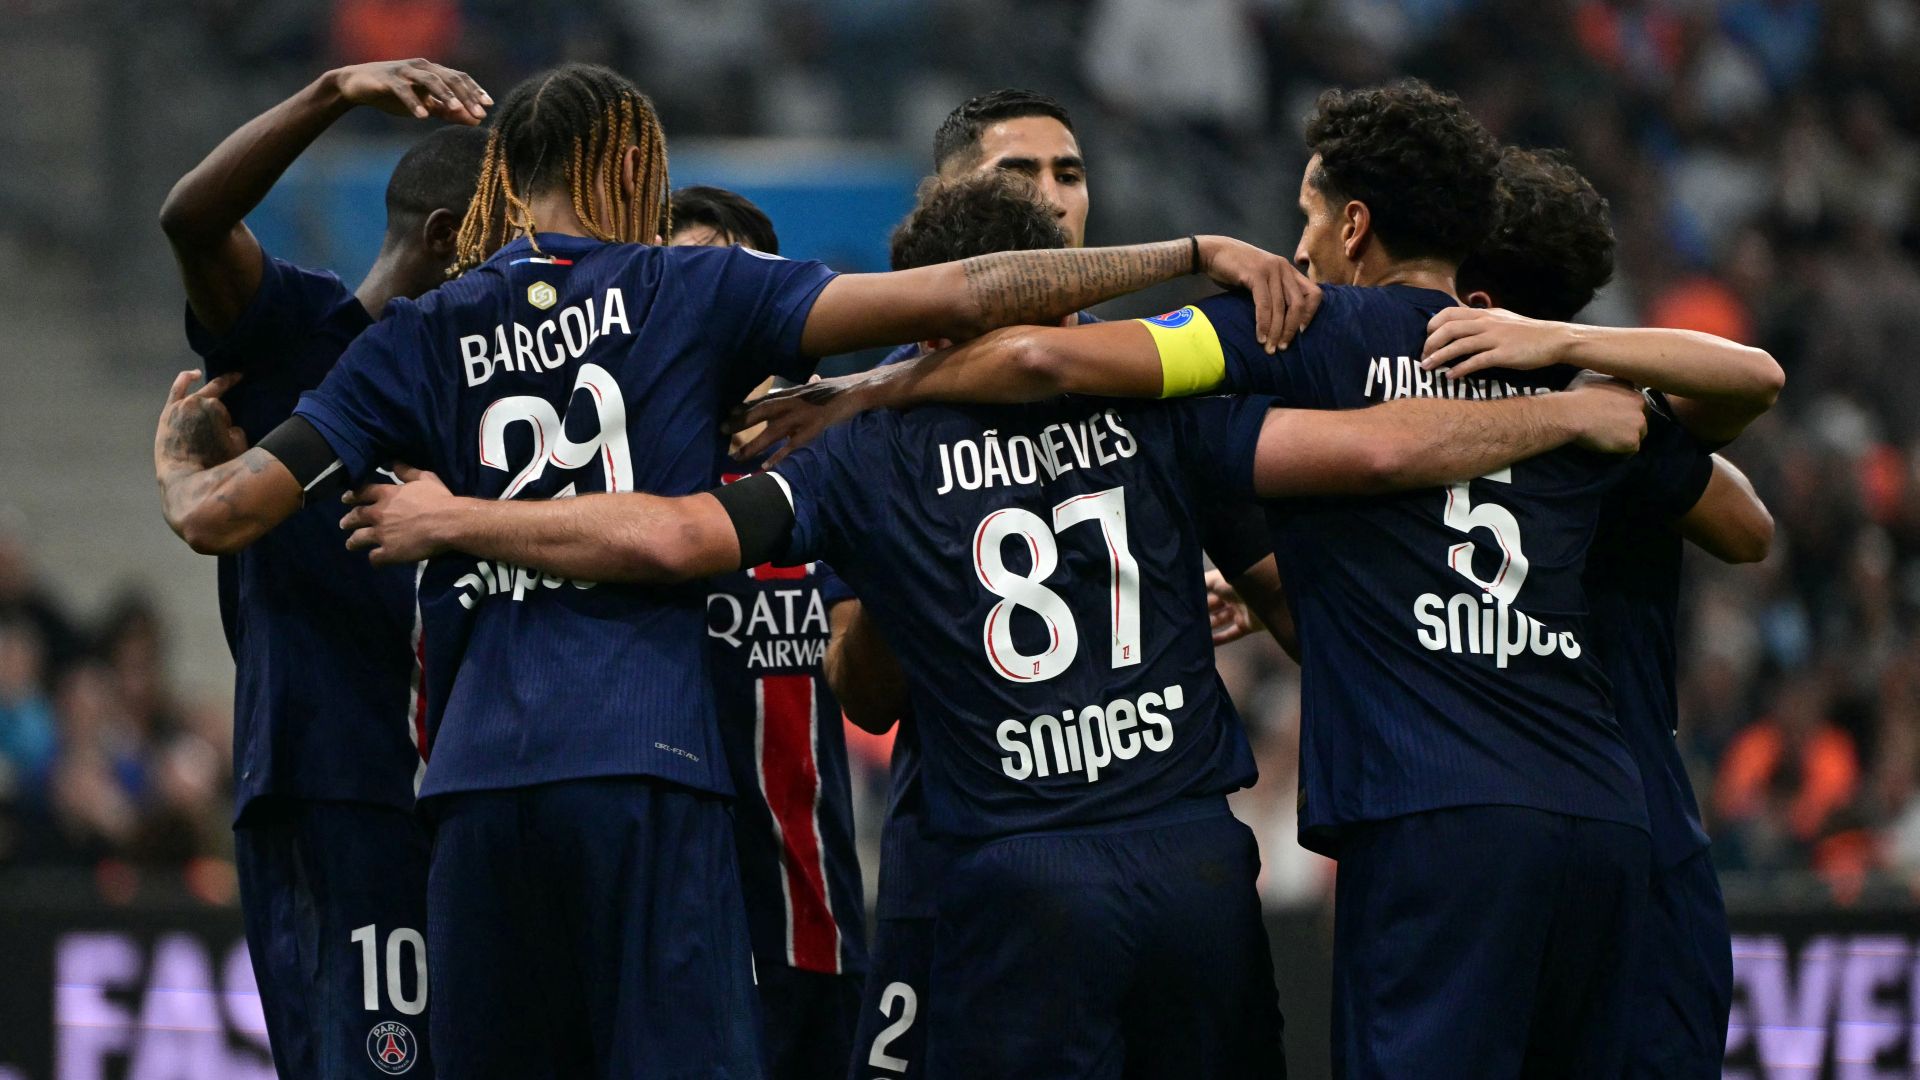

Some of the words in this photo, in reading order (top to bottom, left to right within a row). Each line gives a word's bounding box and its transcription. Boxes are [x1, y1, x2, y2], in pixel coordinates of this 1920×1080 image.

[460, 287, 631, 388] BARCOLA
[478, 363, 635, 500] 29
[1032, 407, 1138, 487] NEVES
[1443, 467, 1529, 604] 5
[707, 588, 829, 649] QATA
[972, 486, 1142, 684] 87
[996, 687, 1175, 783] snipes
[350, 924, 429, 1016] 10
[373, 1023, 407, 1038] PARIS
[868, 981, 918, 1073] 2
